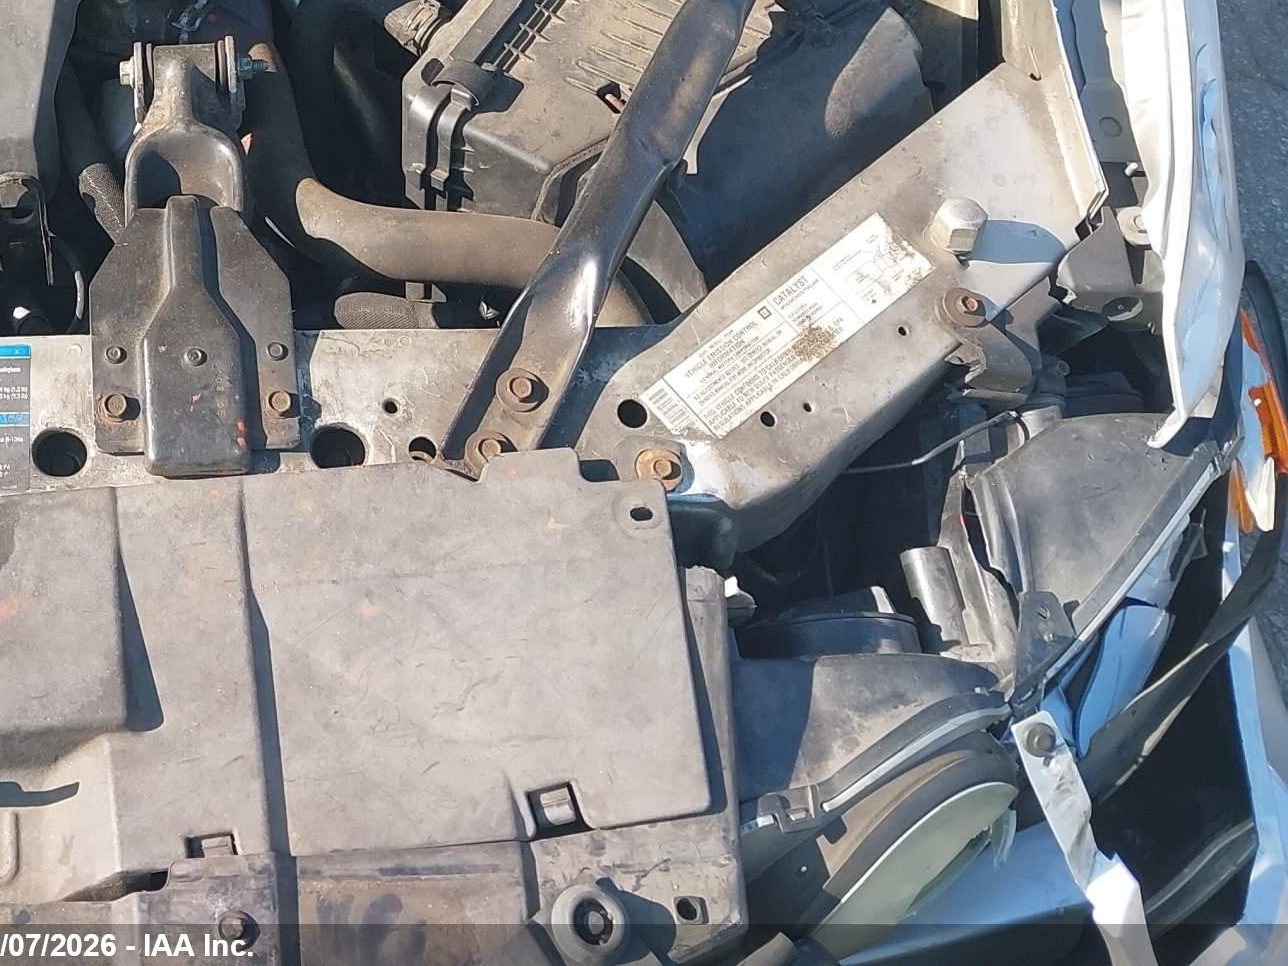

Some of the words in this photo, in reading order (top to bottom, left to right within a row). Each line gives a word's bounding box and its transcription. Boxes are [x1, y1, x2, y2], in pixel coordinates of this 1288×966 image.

[772, 274, 809, 305] CATALYST
[732, 319, 758, 341] CONTROL
[708, 338, 745, 368] INFORMATION
